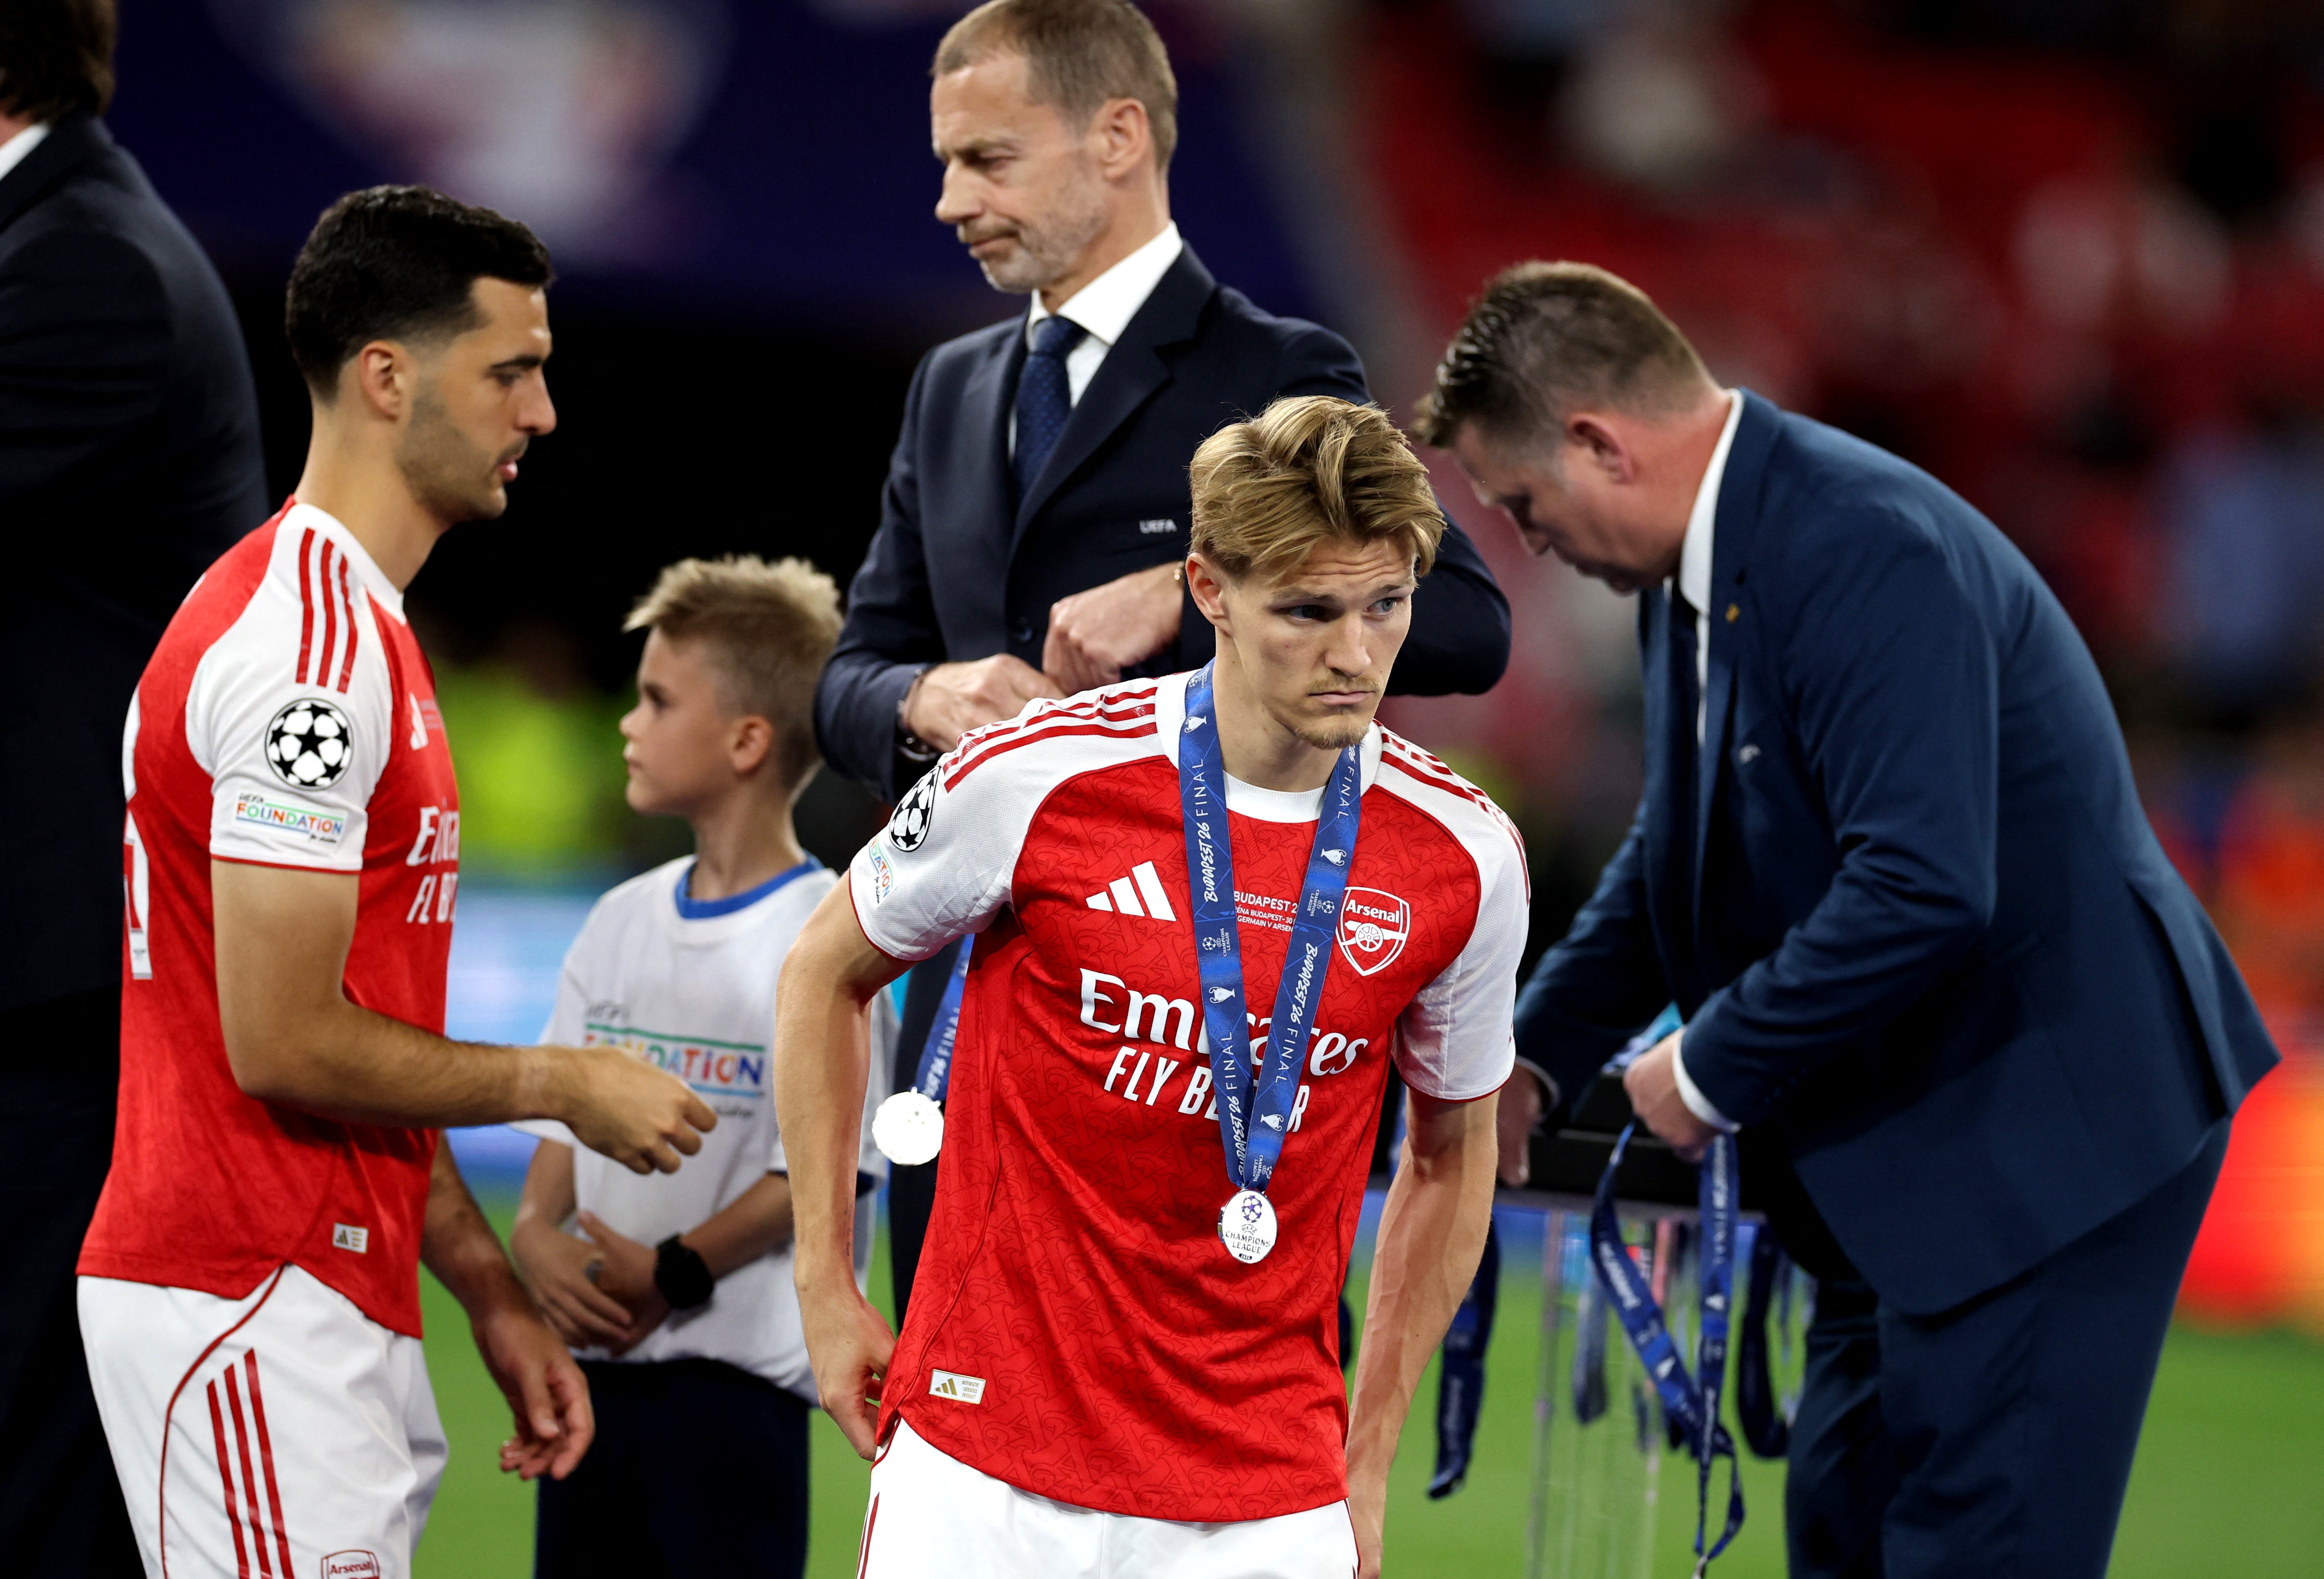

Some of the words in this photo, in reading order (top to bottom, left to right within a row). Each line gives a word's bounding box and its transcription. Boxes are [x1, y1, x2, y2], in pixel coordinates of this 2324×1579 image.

[1139, 519, 1177, 534] UEFA
[1192, 759, 1208, 817] FINAL
[1337, 766, 1355, 819] FINAL
[236, 803, 343, 834] FOUNDATION
[1196, 822, 1211, 840] 26
[1199, 839, 1218, 902] BUDAPEST
[1234, 890, 1291, 912] BUDAPEST
[1235, 905, 1249, 915] ÉNA
[1307, 893, 1315, 912] LEAGUE
[1310, 889, 1320, 917] CHAMPIONS
[1345, 899, 1400, 924] Arsenal
[1238, 915, 1266, 927] GERMAIN
[1294, 943, 1318, 1008] BUDAPEST
[1290, 1004, 1303, 1024] 26
[1221, 1032, 1238, 1090] FINAL
[1275, 1027, 1298, 1084] FINAL
[1104, 1046, 1179, 1106] FLY
[1227, 1096, 1242, 1114] 26
[1253, 1155, 1264, 1182] CHAMPIONS
[1225, 1231, 1270, 1248] CHAMPIONS
[1232, 1241, 1261, 1254] LEAGUE
[330, 1561, 372, 1575] Arsenal
